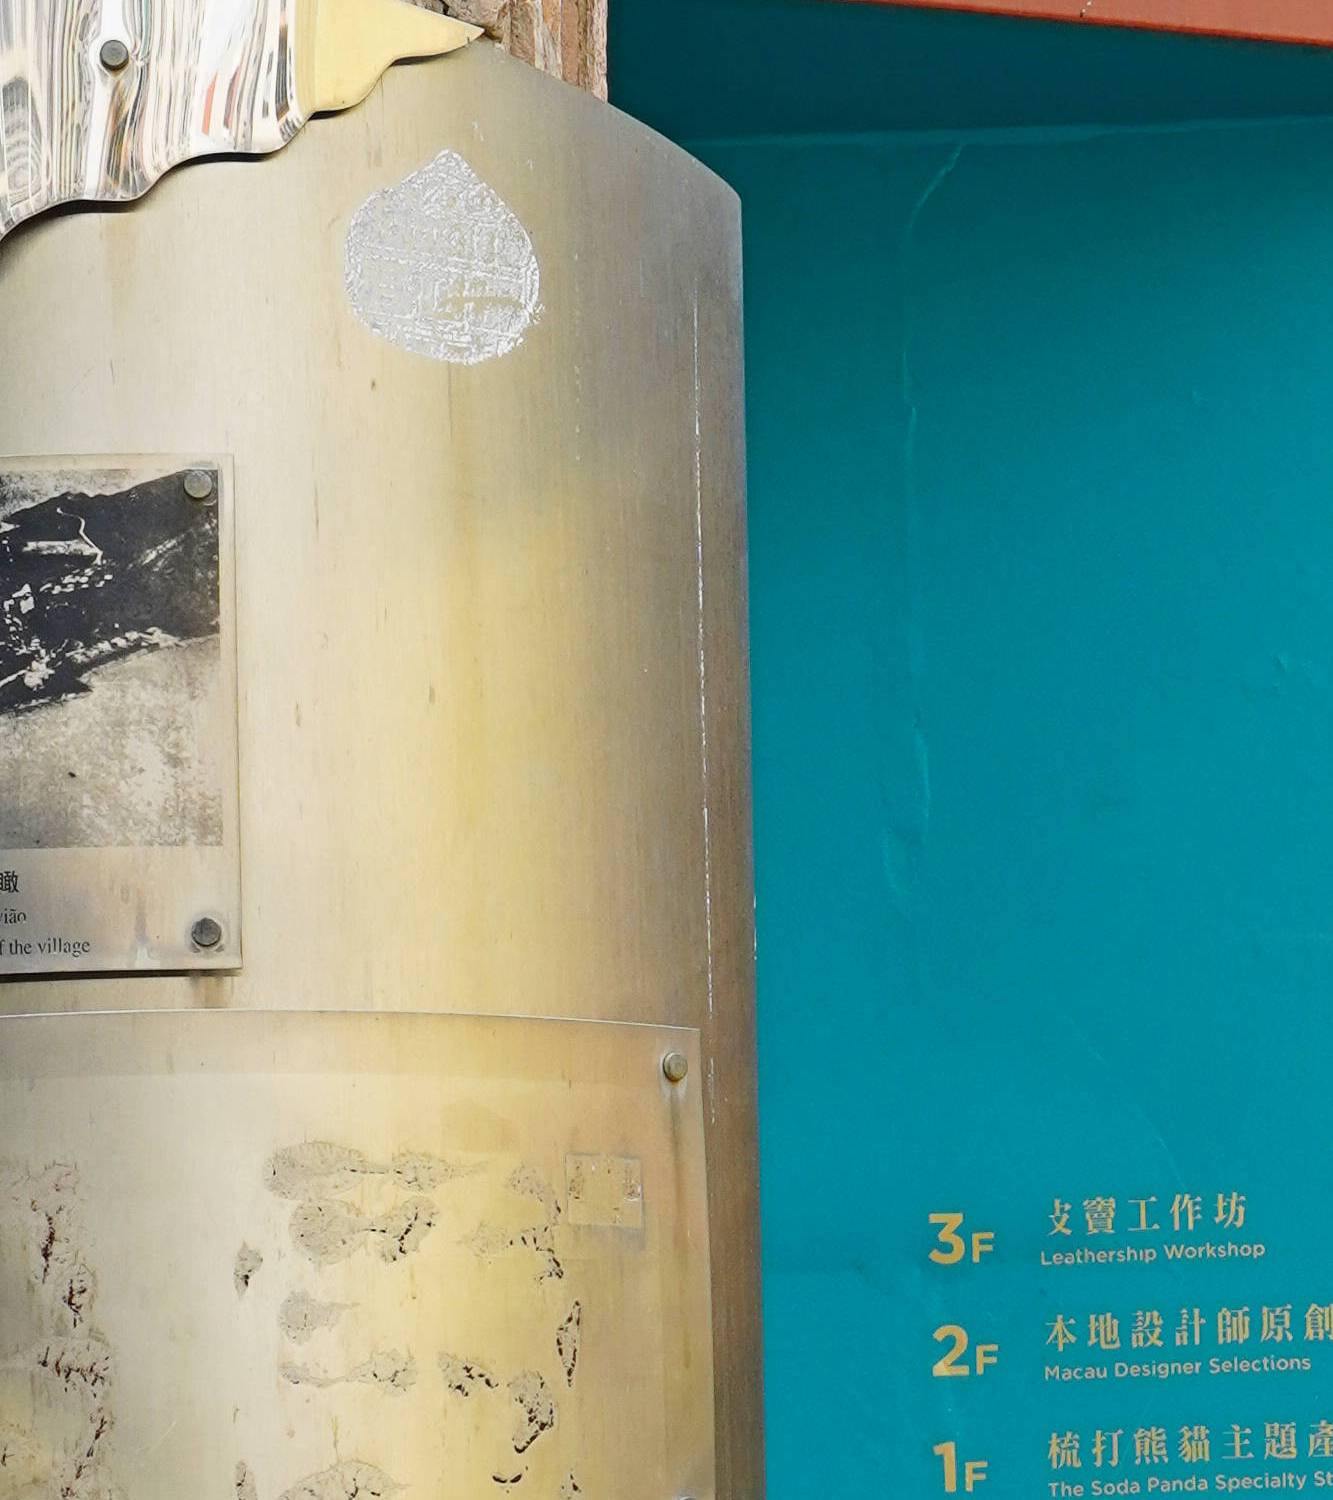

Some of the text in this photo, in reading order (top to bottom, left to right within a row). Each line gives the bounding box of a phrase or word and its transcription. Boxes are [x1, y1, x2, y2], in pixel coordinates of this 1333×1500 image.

[0, 907, 26, 924] ião
[9, 940, 32, 955] the
[37, 938, 91, 957] village
[928, 1212, 994, 1265] 3F
[1040, 1239, 1265, 1267] Leathership Workshop
[932, 1324, 999, 1378] 2F
[1044, 1354, 1311, 1381] Macau Designer Selections
[933, 1440, 988, 1493] 1F
[1048, 1481, 1084, 1498] The
[1091, 1478, 1141, 1496] Soda
[1147, 1475, 1208, 1494] Panda
[1215, 1471, 1307, 1491] Specialty
